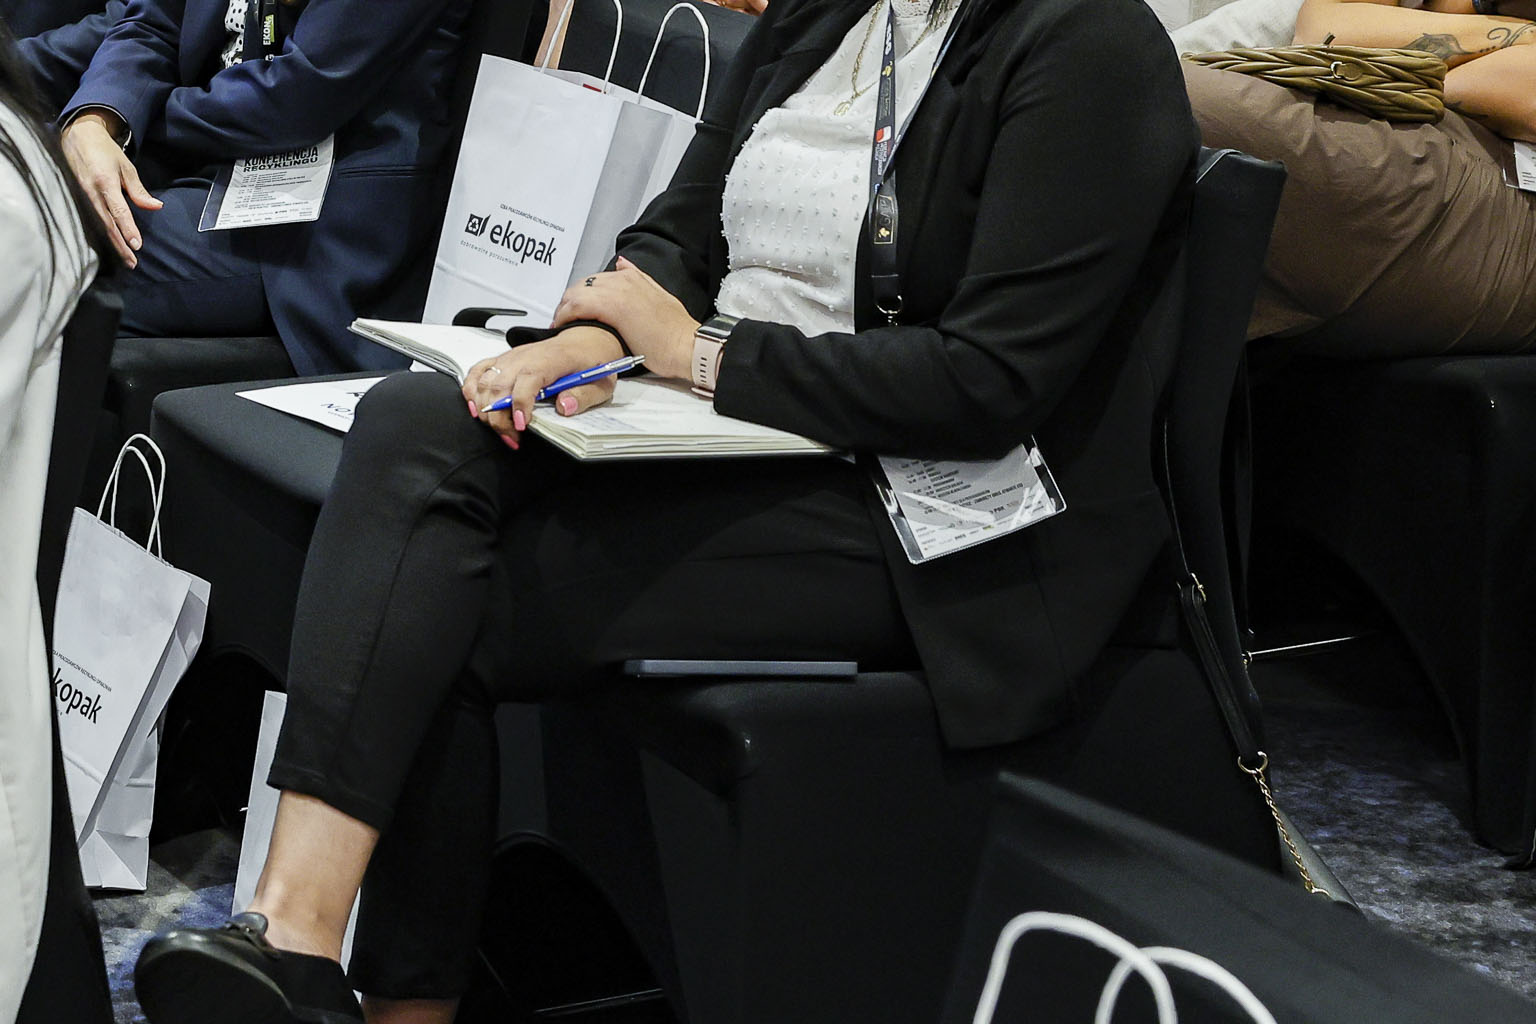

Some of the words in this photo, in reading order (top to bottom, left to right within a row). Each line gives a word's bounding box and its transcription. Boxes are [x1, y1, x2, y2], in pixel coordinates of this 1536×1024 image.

[243, 157, 318, 173] RECYKLINGU
[244, 146, 319, 168] KONFERENCJA
[489, 220, 558, 267] ekopak
[53, 667, 103, 725] kopak
